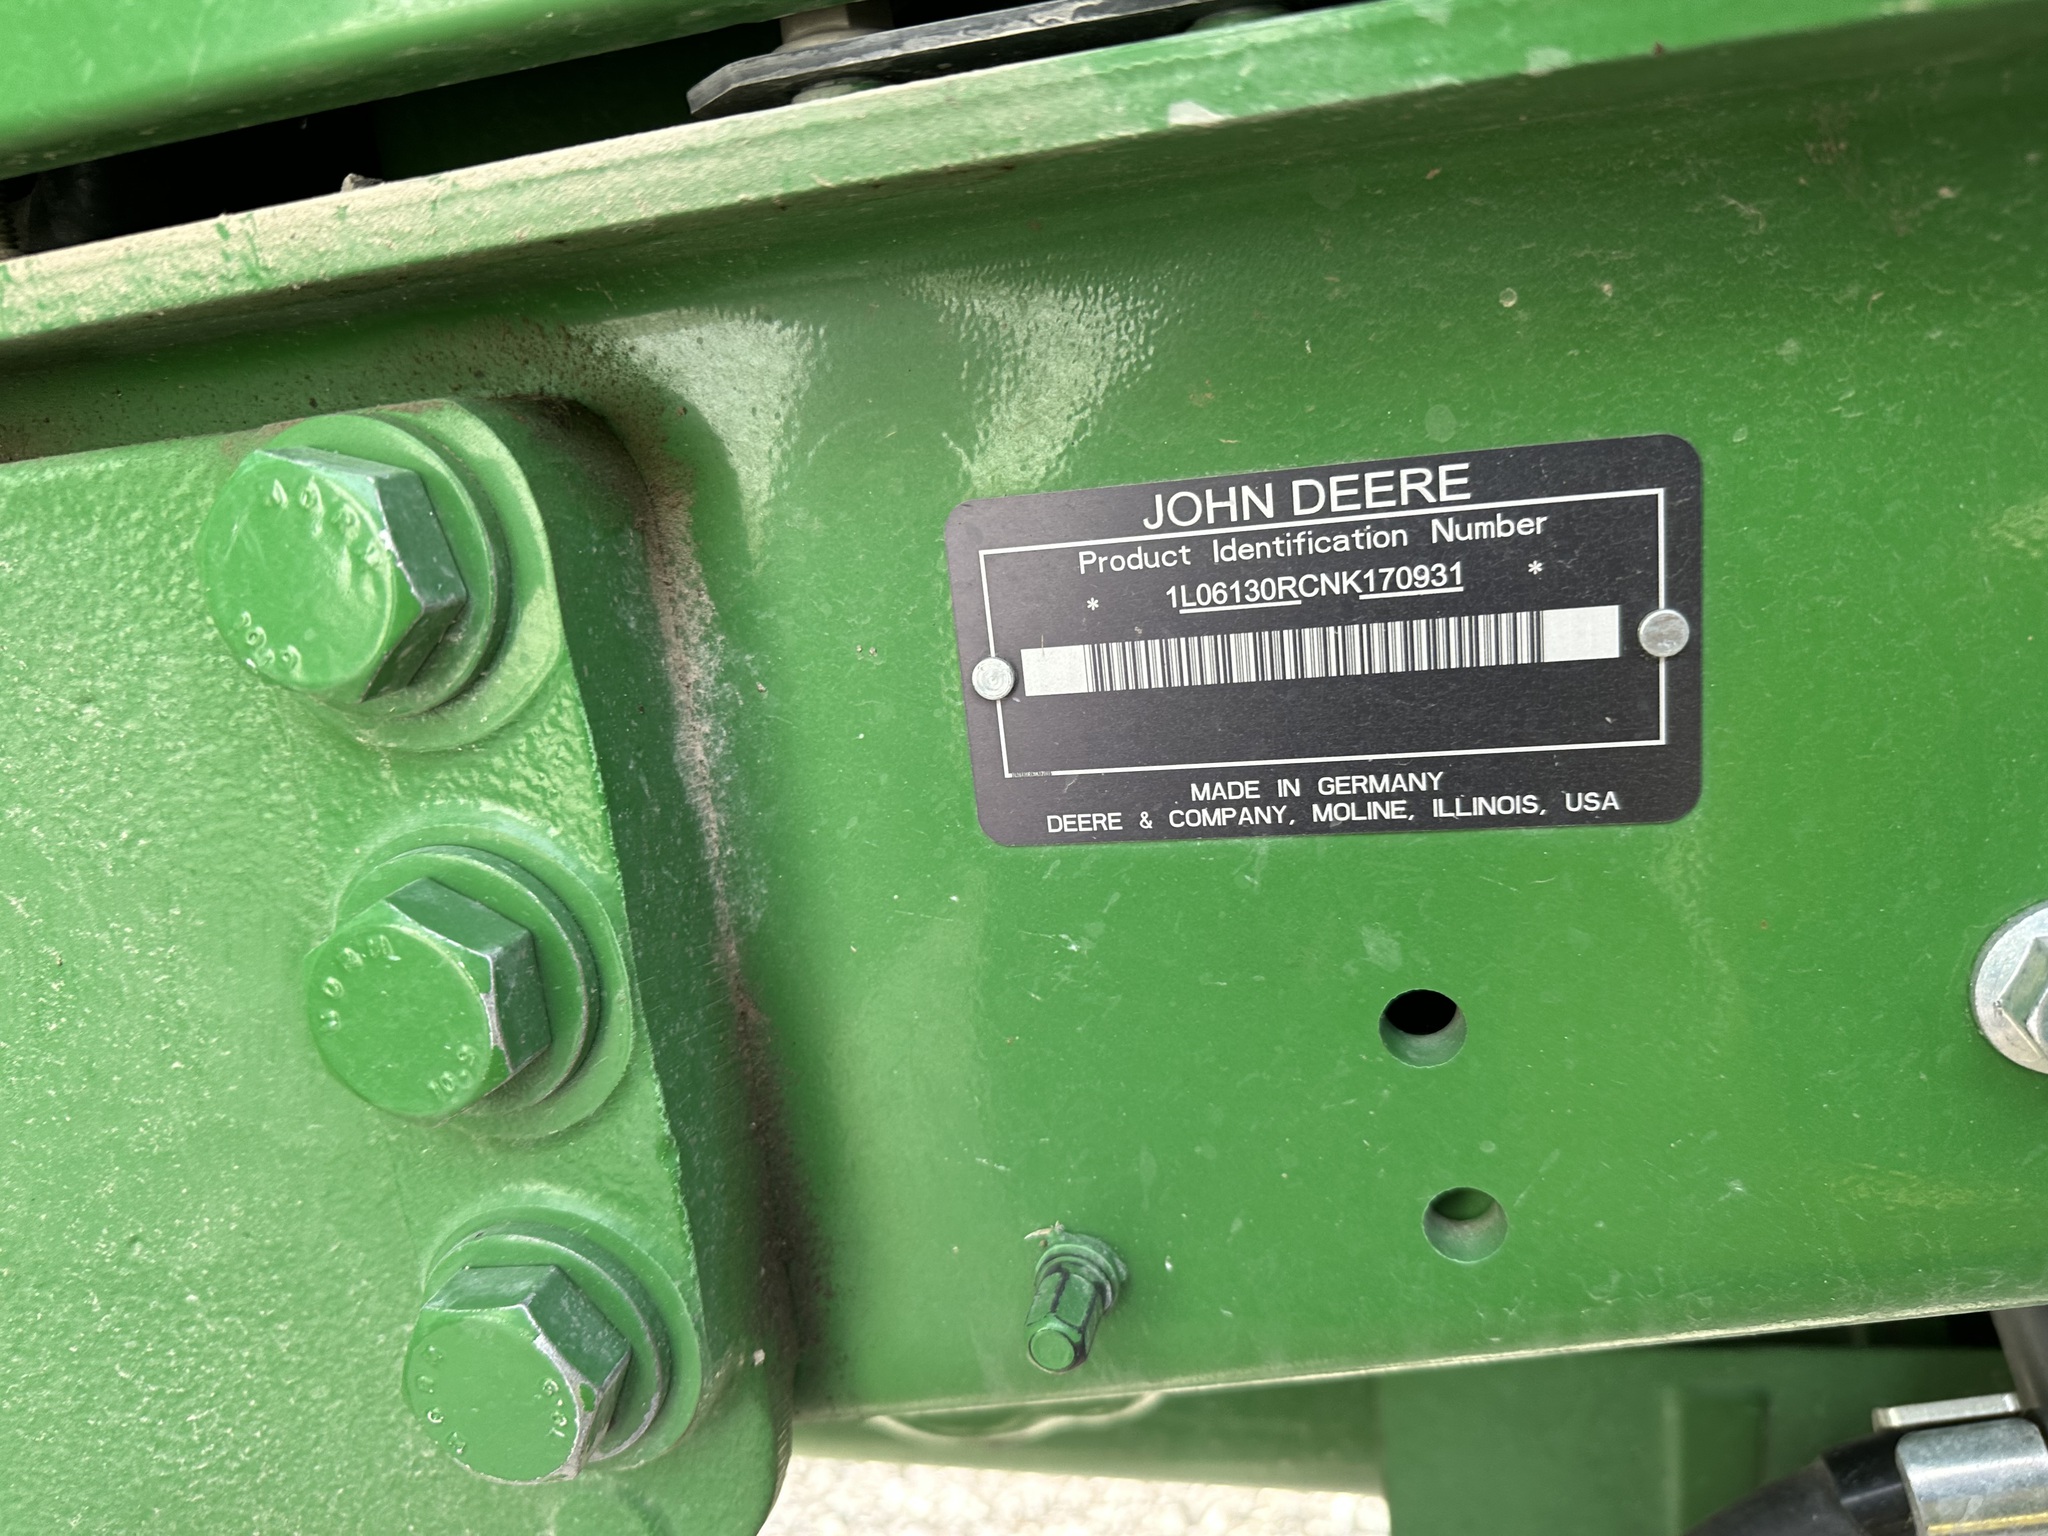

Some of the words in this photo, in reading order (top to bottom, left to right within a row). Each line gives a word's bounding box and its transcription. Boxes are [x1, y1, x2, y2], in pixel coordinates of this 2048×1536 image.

[1143, 482, 1275, 530] JOHN
[1291, 462, 1472, 517] DEERE
[1078, 544, 1193, 575] Product
[1212, 526, 1409, 565] Identification
[1431, 512, 1549, 545] Number
[1166, 560, 1464, 610] 1L06130RCNK170931
[1046, 811, 1124, 834] DEERE
[1139, 810, 1154, 830] &
[1311, 798, 1415, 824] MOLINE,
[1432, 794, 1547, 820] ILLINOIS,
[1565, 790, 1621, 812] USA
[1190, 779, 1262, 802] MADE
[1277, 778, 1301, 798] IN
[1317, 772, 1444, 797] GERMANY
